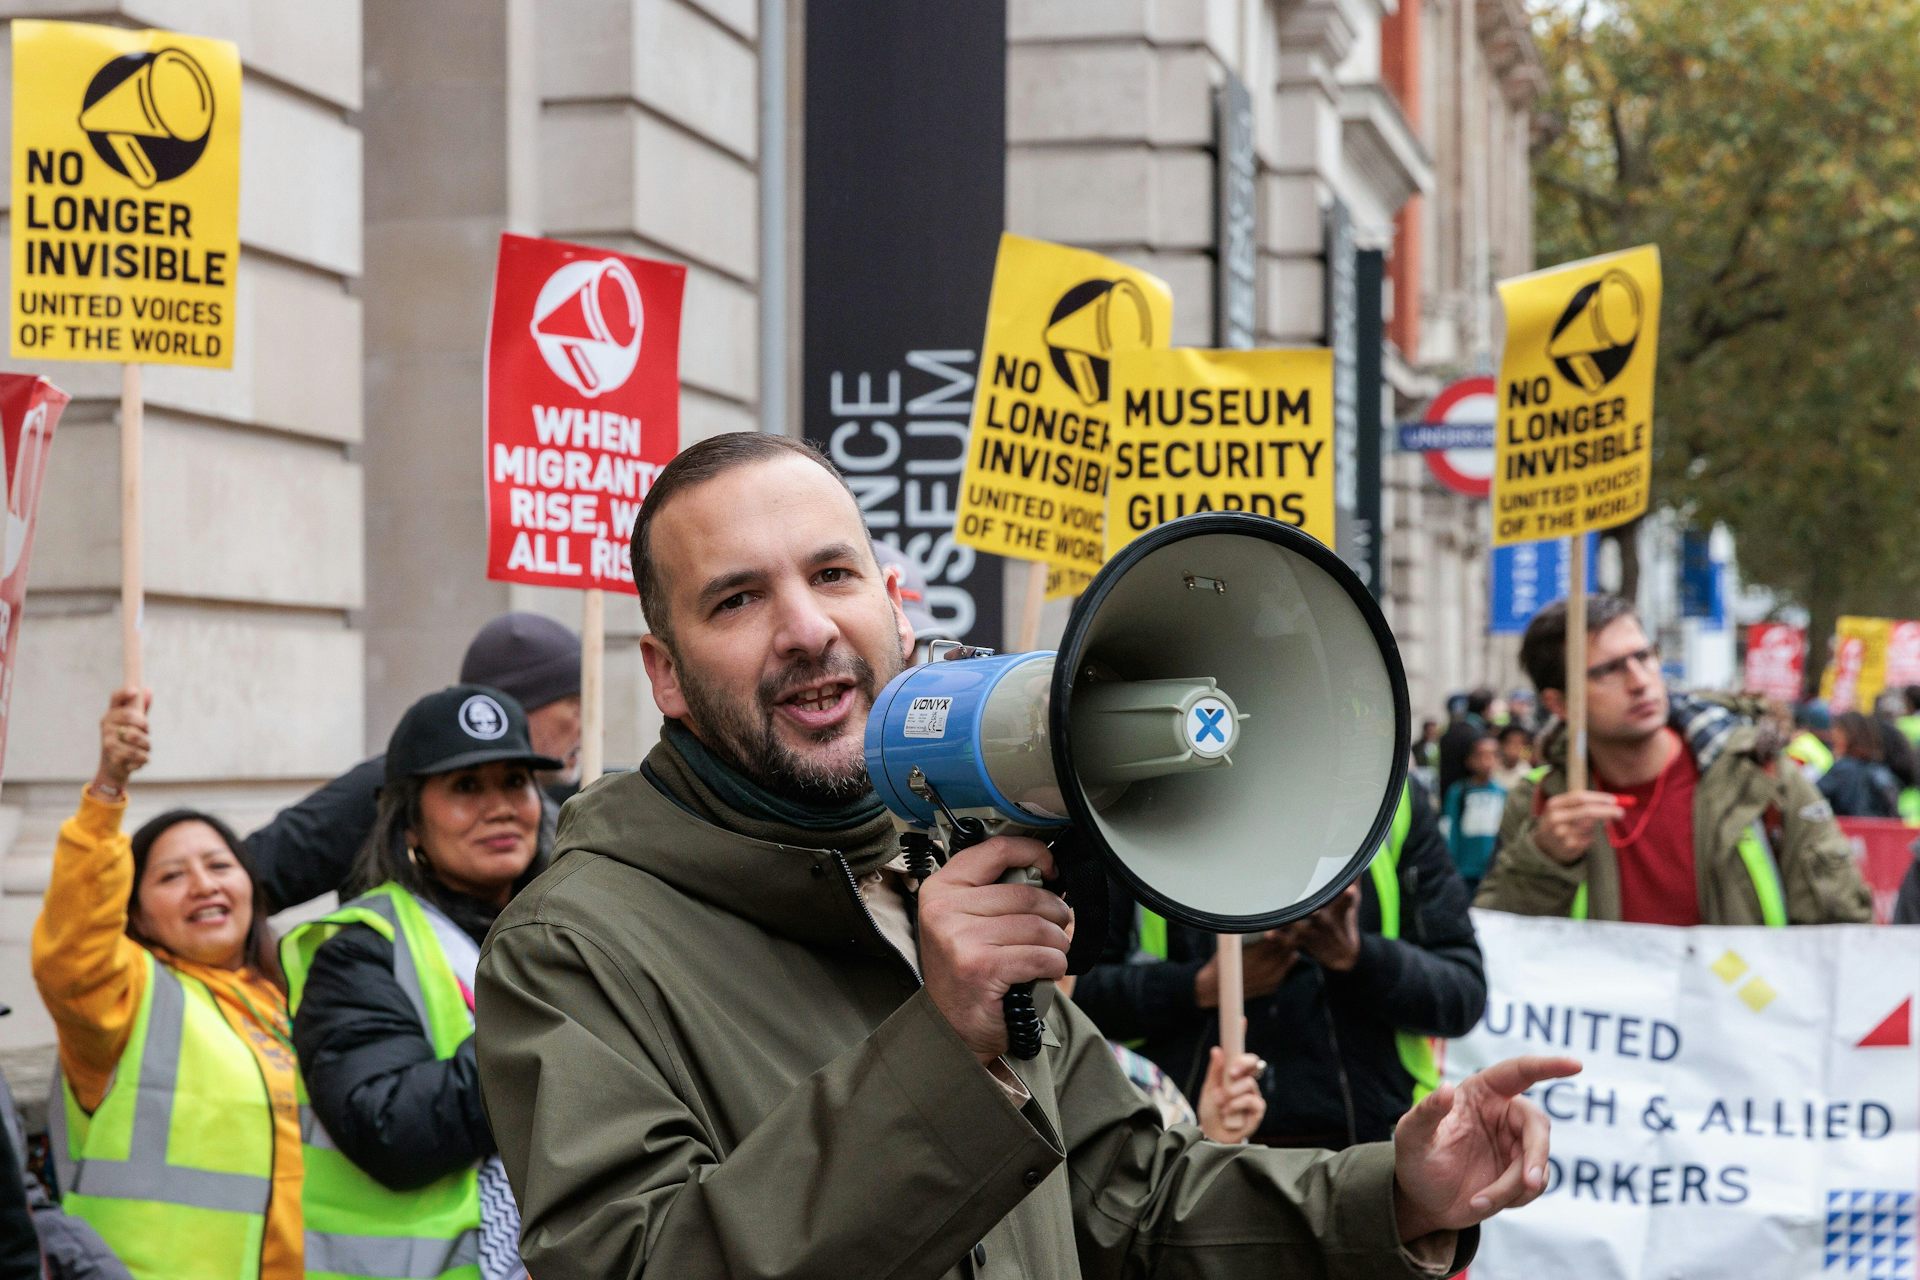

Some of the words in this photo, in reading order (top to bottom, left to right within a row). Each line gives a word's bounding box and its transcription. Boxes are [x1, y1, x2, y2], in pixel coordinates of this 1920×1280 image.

[27, 149, 84, 186] NO
[27, 195, 192, 239] LONGER
[26, 241, 226, 286] INVISIBLE
[20, 292, 122, 318] UNITED
[131, 296, 223, 325] VOICES
[19, 324, 55, 348] OF
[65, 326, 121, 350] THE
[131, 330, 222, 358] WORLD
[994, 353, 1040, 393] NO
[1509, 375, 1550, 408] NO
[532, 404, 641, 456] WHEN
[1125, 389, 1310, 426] MUSEUM
[1508, 397, 1626, 444] LONGER
[1115, 441, 1323, 479] SECURITY
[1506, 423, 1643, 481] INVISIBLE
[509, 487, 608, 540] RISE,
[610, 498, 642, 540] W
[904, 349, 977, 661] USEUM
[968, 485, 1054, 520] UNITED
[1061, 503, 1104, 533] VOIC
[1500, 484, 1578, 512] UNITED
[963, 514, 993, 537] OF
[1003, 521, 1048, 550] THE
[1056, 533, 1104, 564] WOR
[1499, 516, 1525, 537] OF
[1537, 508, 1574, 531] THE
[507, 532, 582, 576] ALL
[590, 537, 635, 583] RIS
[1484, 1001, 1681, 1062] UNITED
[1526, 1082, 1617, 1126] CH
[1642, 1095, 1678, 1133] &
[1700, 1099, 1894, 1140] ALLIED
[1545, 1156, 1751, 1204] ORKERS
